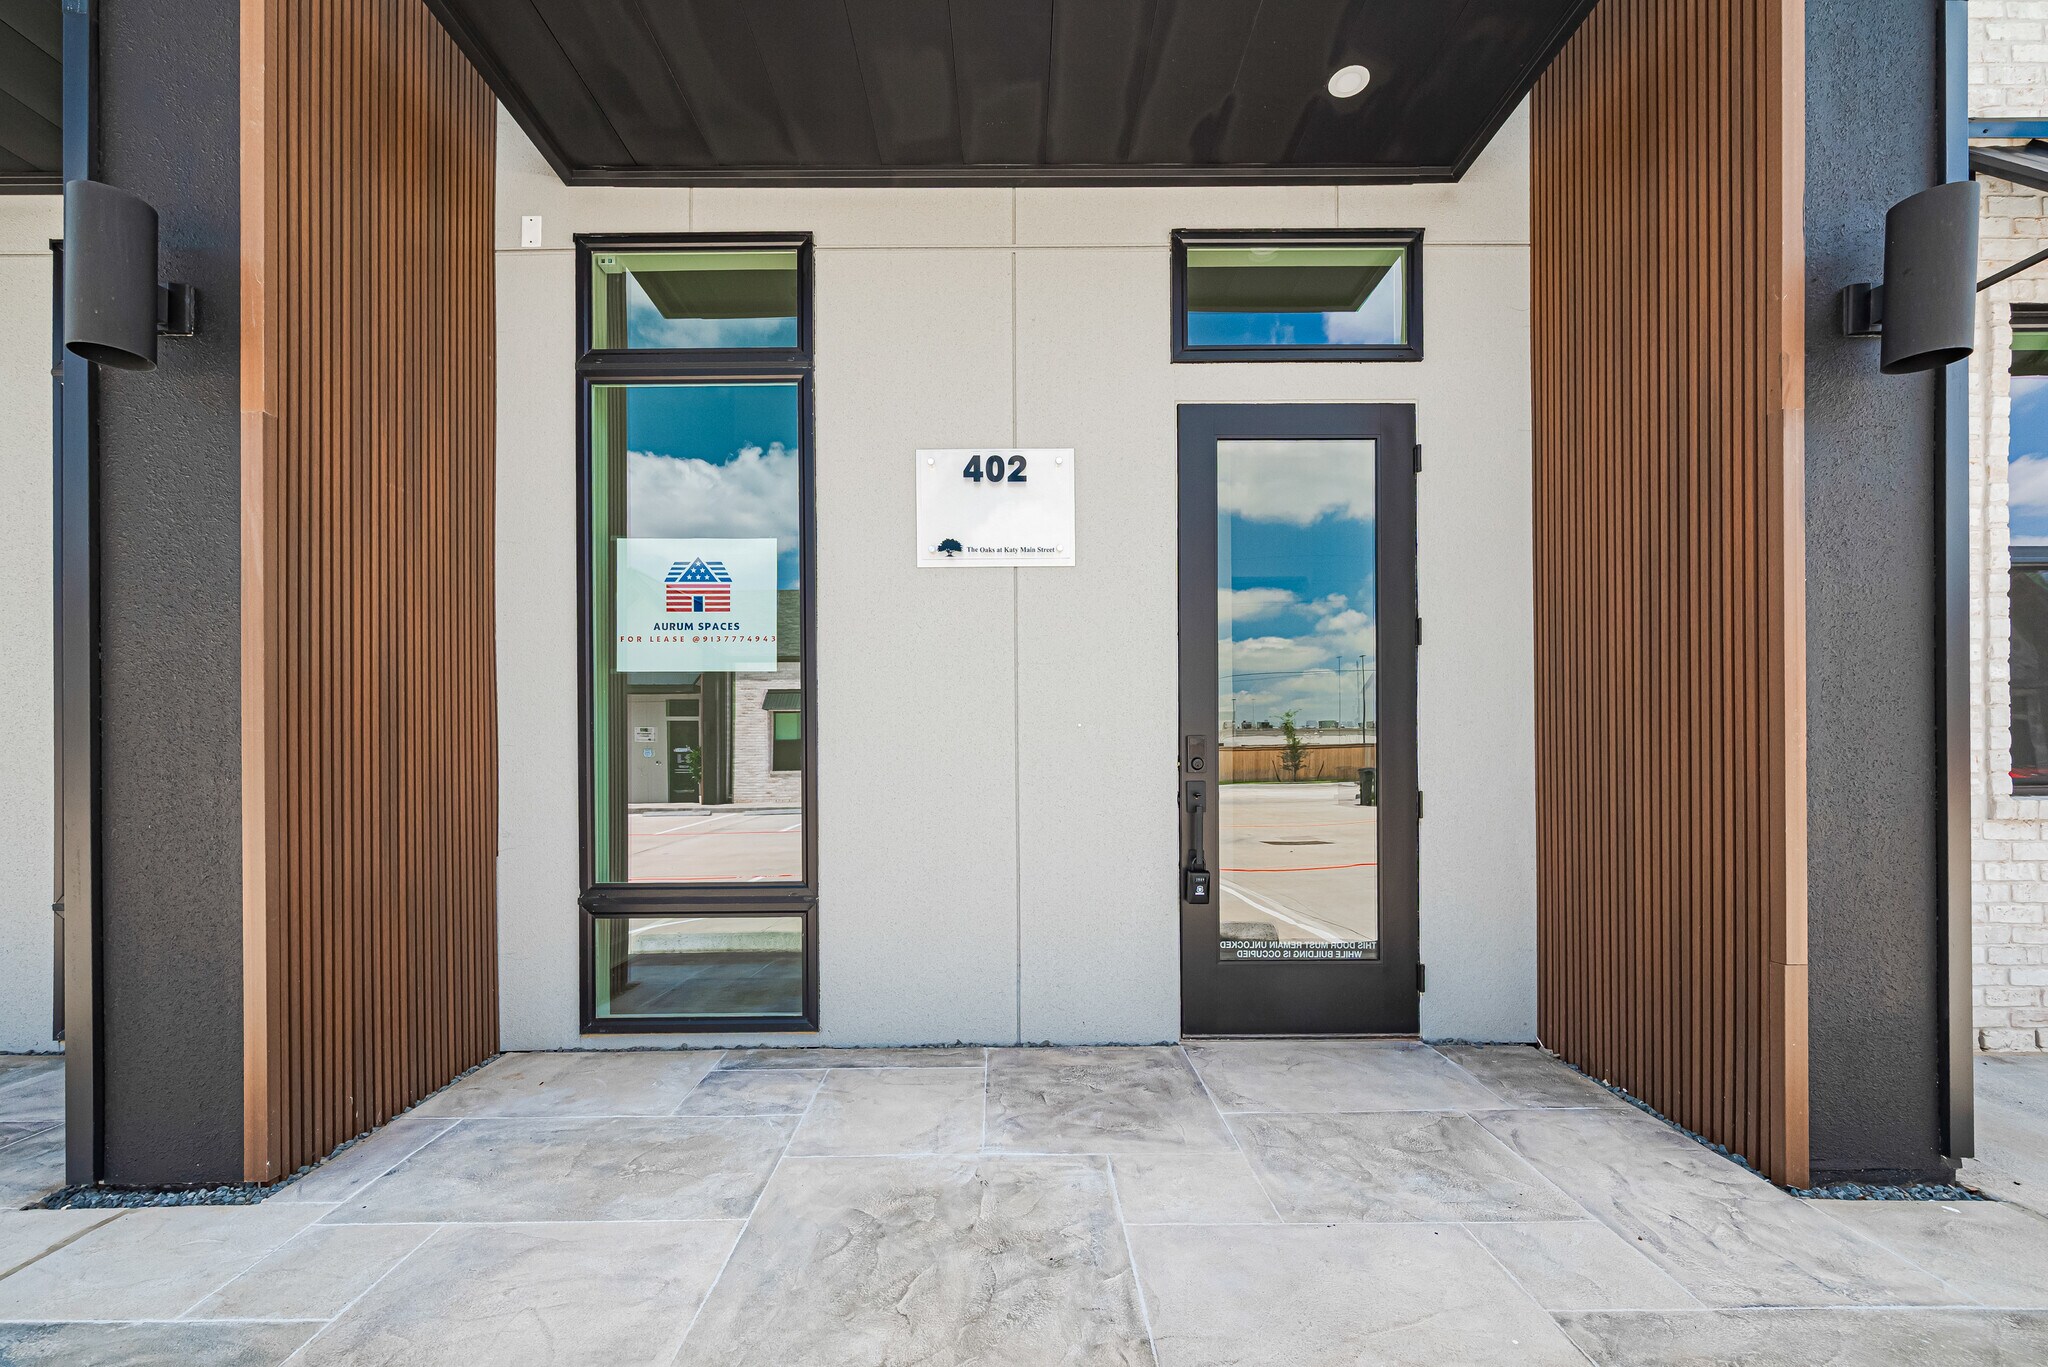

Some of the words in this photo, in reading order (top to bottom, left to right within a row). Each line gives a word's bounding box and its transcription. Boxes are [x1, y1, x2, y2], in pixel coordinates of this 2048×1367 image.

[963, 455, 1027, 483] 402
[1004, 546, 1018, 555] Katy
[654, 622, 694, 631] AURUM
[698, 622, 740, 631] SPACES
[620, 635, 642, 643] FOR
[650, 635, 685, 643] LEASE
[692, 635, 776, 643] @9137774943
